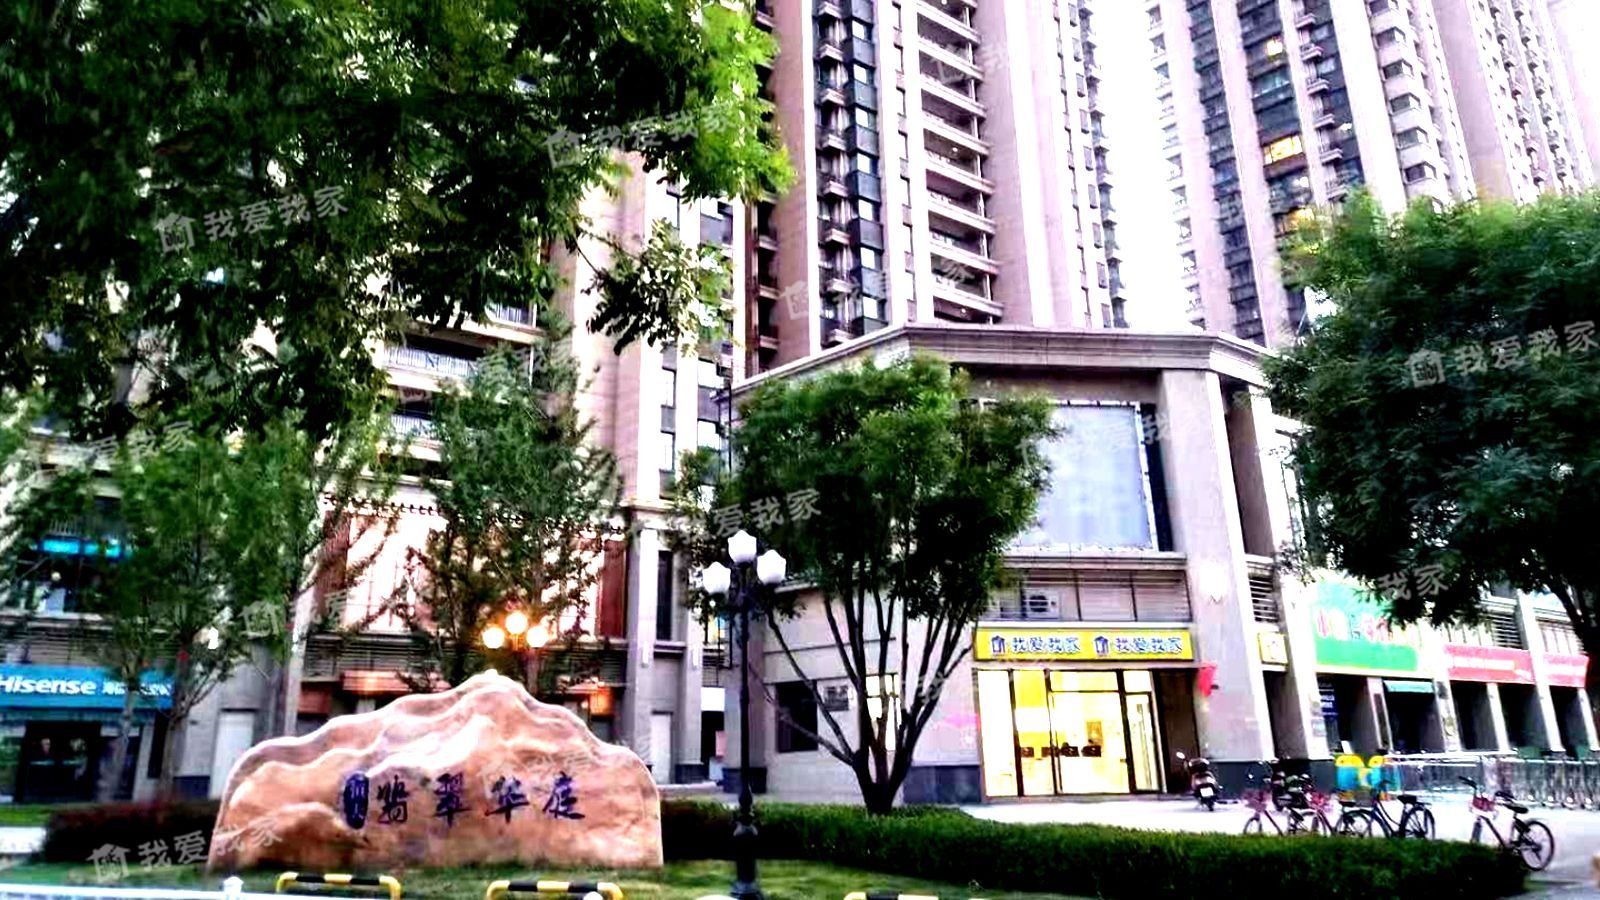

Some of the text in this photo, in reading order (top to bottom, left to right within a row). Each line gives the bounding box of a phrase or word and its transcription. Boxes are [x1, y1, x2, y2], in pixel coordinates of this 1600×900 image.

[1011, 635, 1082, 654] 我爱我家
[1115, 635, 1184, 655] 我爱我家
[0, 675, 97, 695] Hisense
[376, 771, 586, 827] 翡翠华庭
